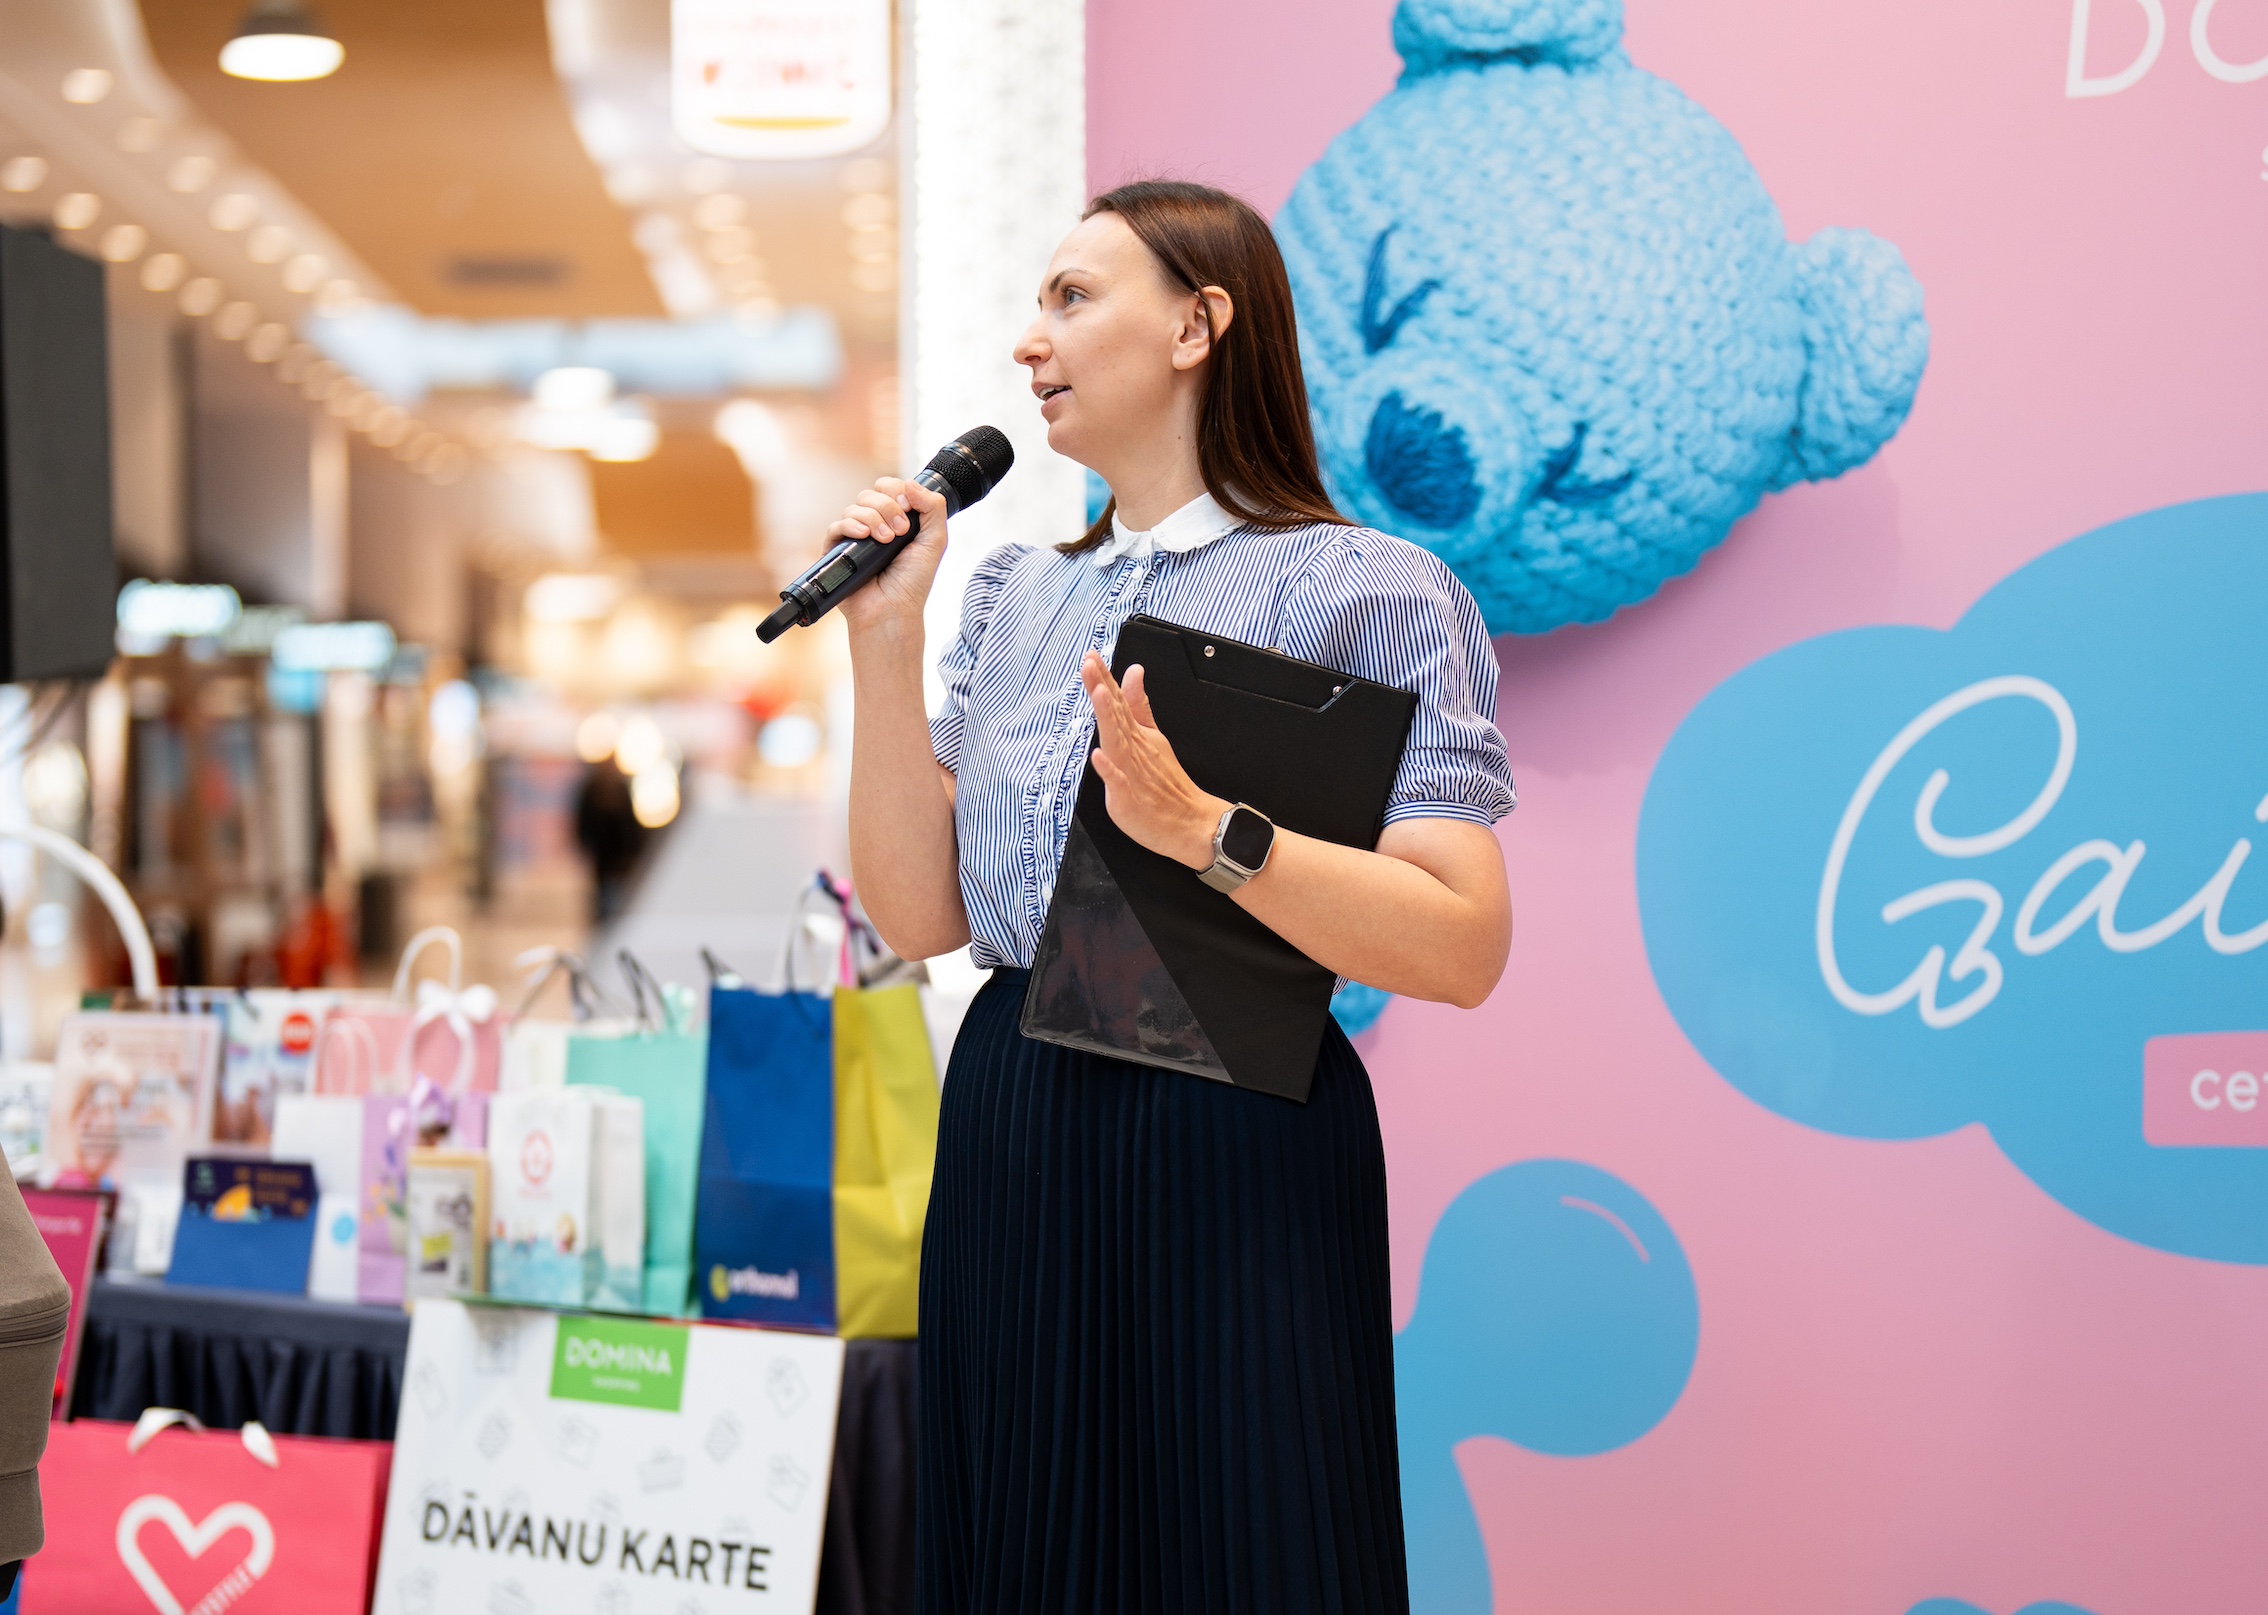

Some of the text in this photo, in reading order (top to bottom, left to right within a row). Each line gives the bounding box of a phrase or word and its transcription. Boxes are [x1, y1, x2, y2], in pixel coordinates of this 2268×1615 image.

[2191, 1068, 2268, 1112] ce
[565, 1335, 673, 1377] DOMINA
[422, 1491, 773, 1591] DĀVANU KARTE
